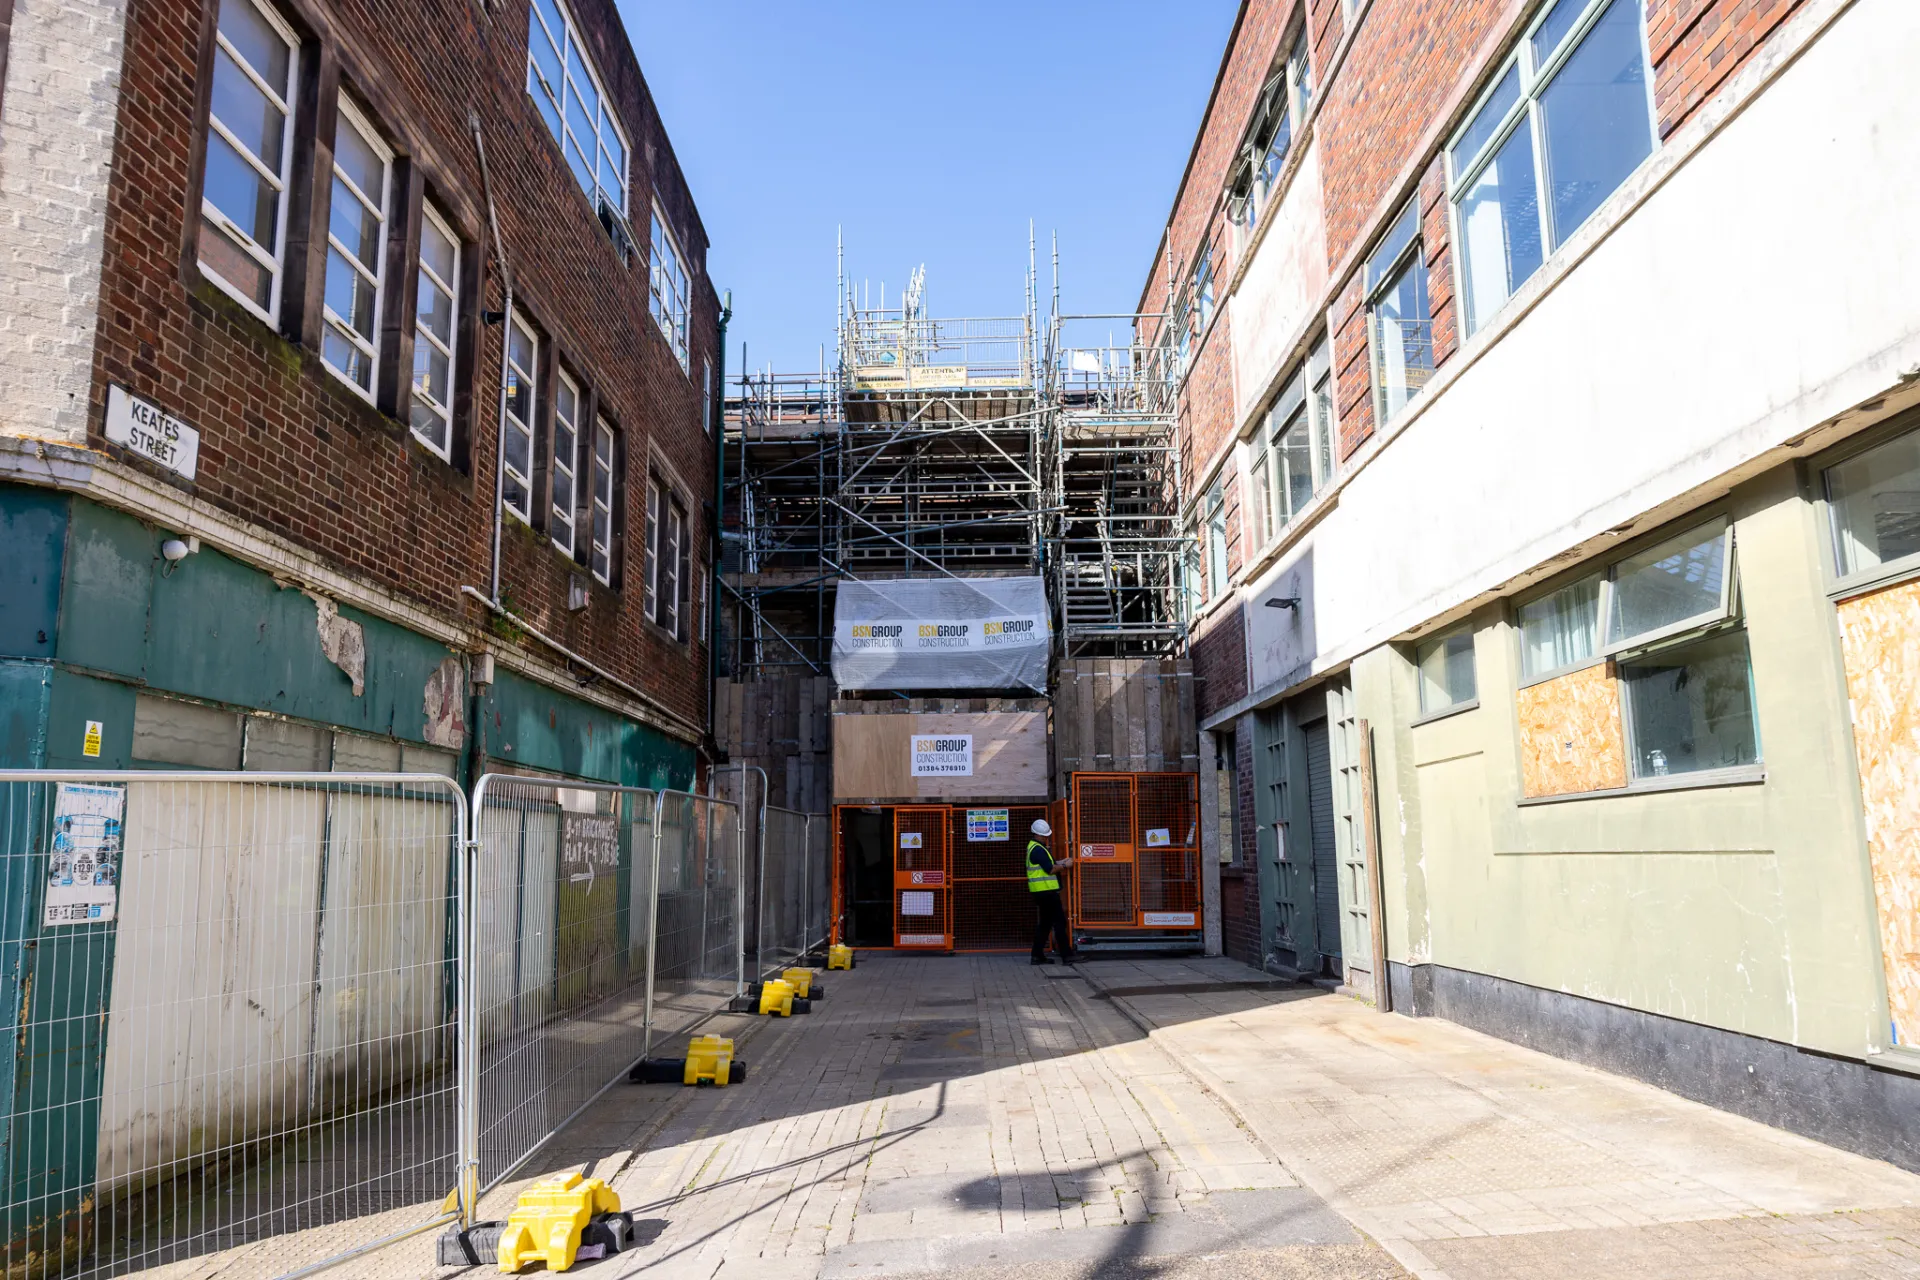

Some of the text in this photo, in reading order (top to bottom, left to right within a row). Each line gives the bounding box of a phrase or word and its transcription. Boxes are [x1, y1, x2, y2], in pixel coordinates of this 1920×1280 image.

[131, 401, 179, 441] KEATES
[129, 427, 177, 464] STREET
[852, 637, 903, 648] CONSTRUCTION
[918, 637, 969, 647] CONSTRUCTION
[984, 632, 1035, 645] CONSTRUCTION
[916, 753, 967, 763] CONSTRUCTION
